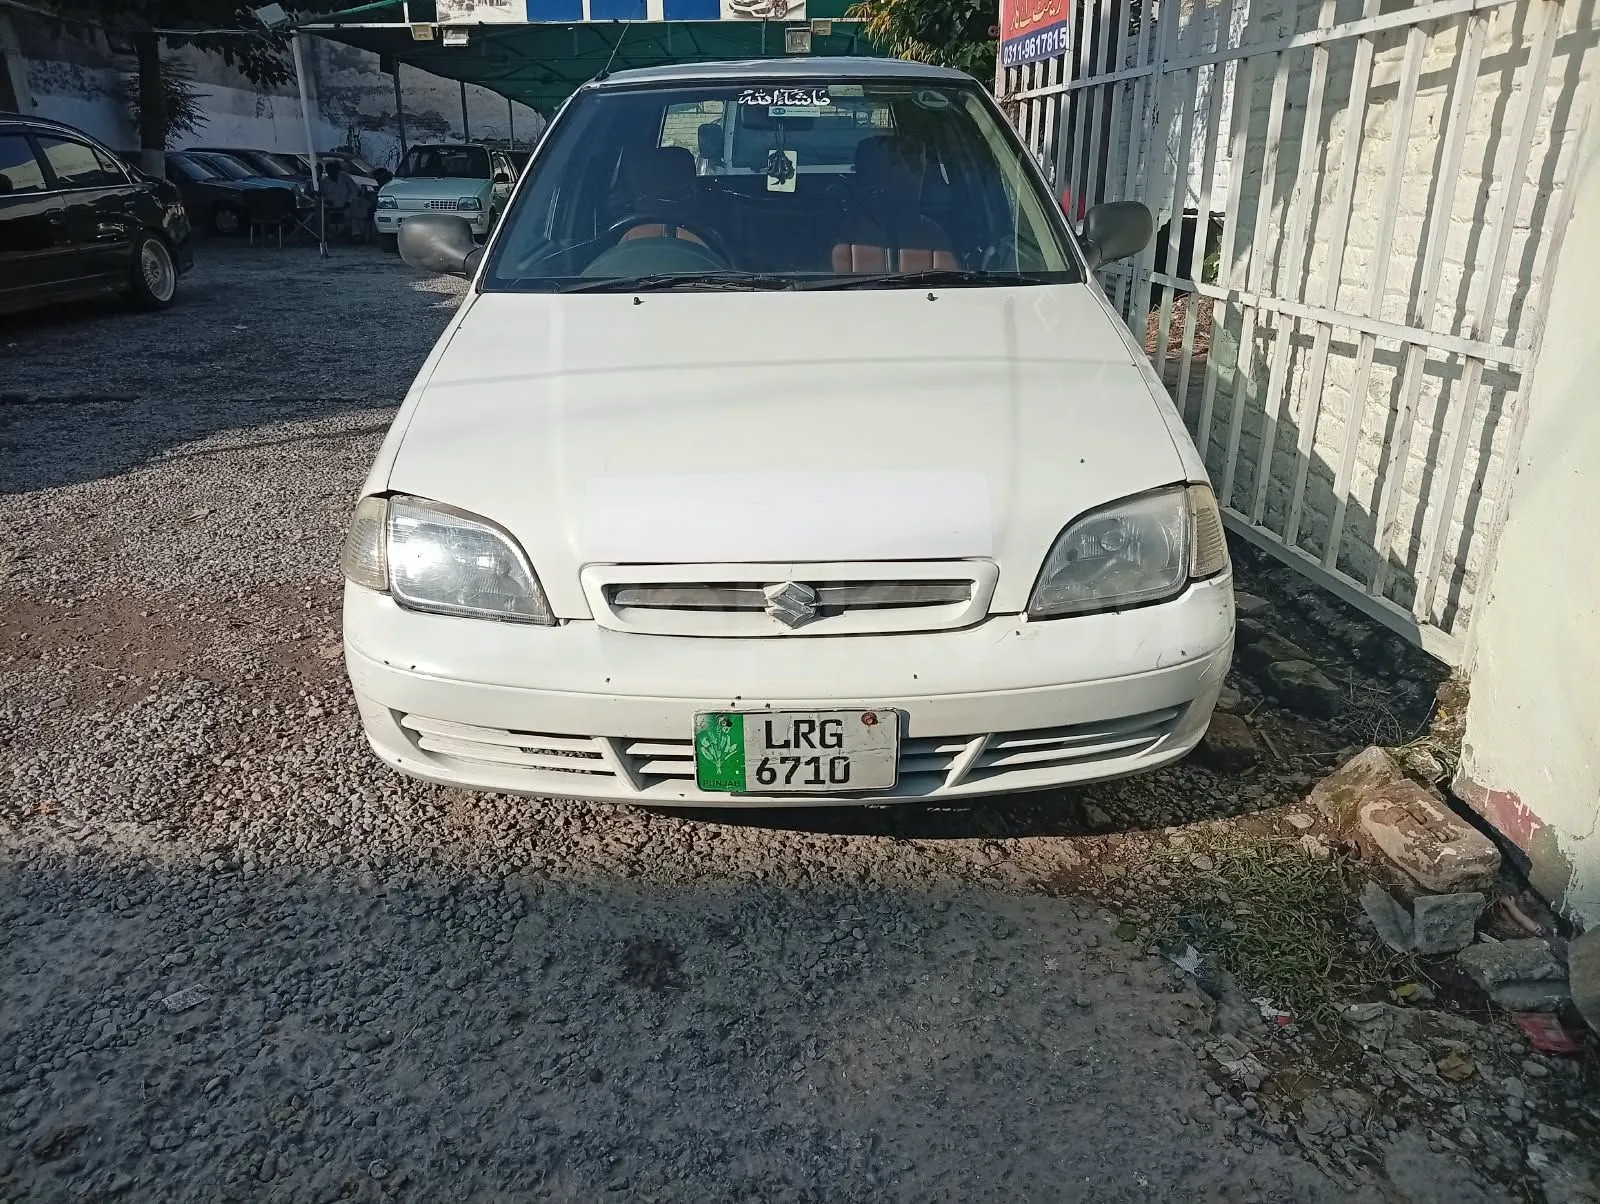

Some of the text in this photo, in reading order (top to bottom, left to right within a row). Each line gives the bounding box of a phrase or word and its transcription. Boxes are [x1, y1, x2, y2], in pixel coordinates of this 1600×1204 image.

[1003, 27, 1067, 65] 0311-9617815
[764, 718, 844, 750] LRG
[755, 755, 850, 785] 6710
